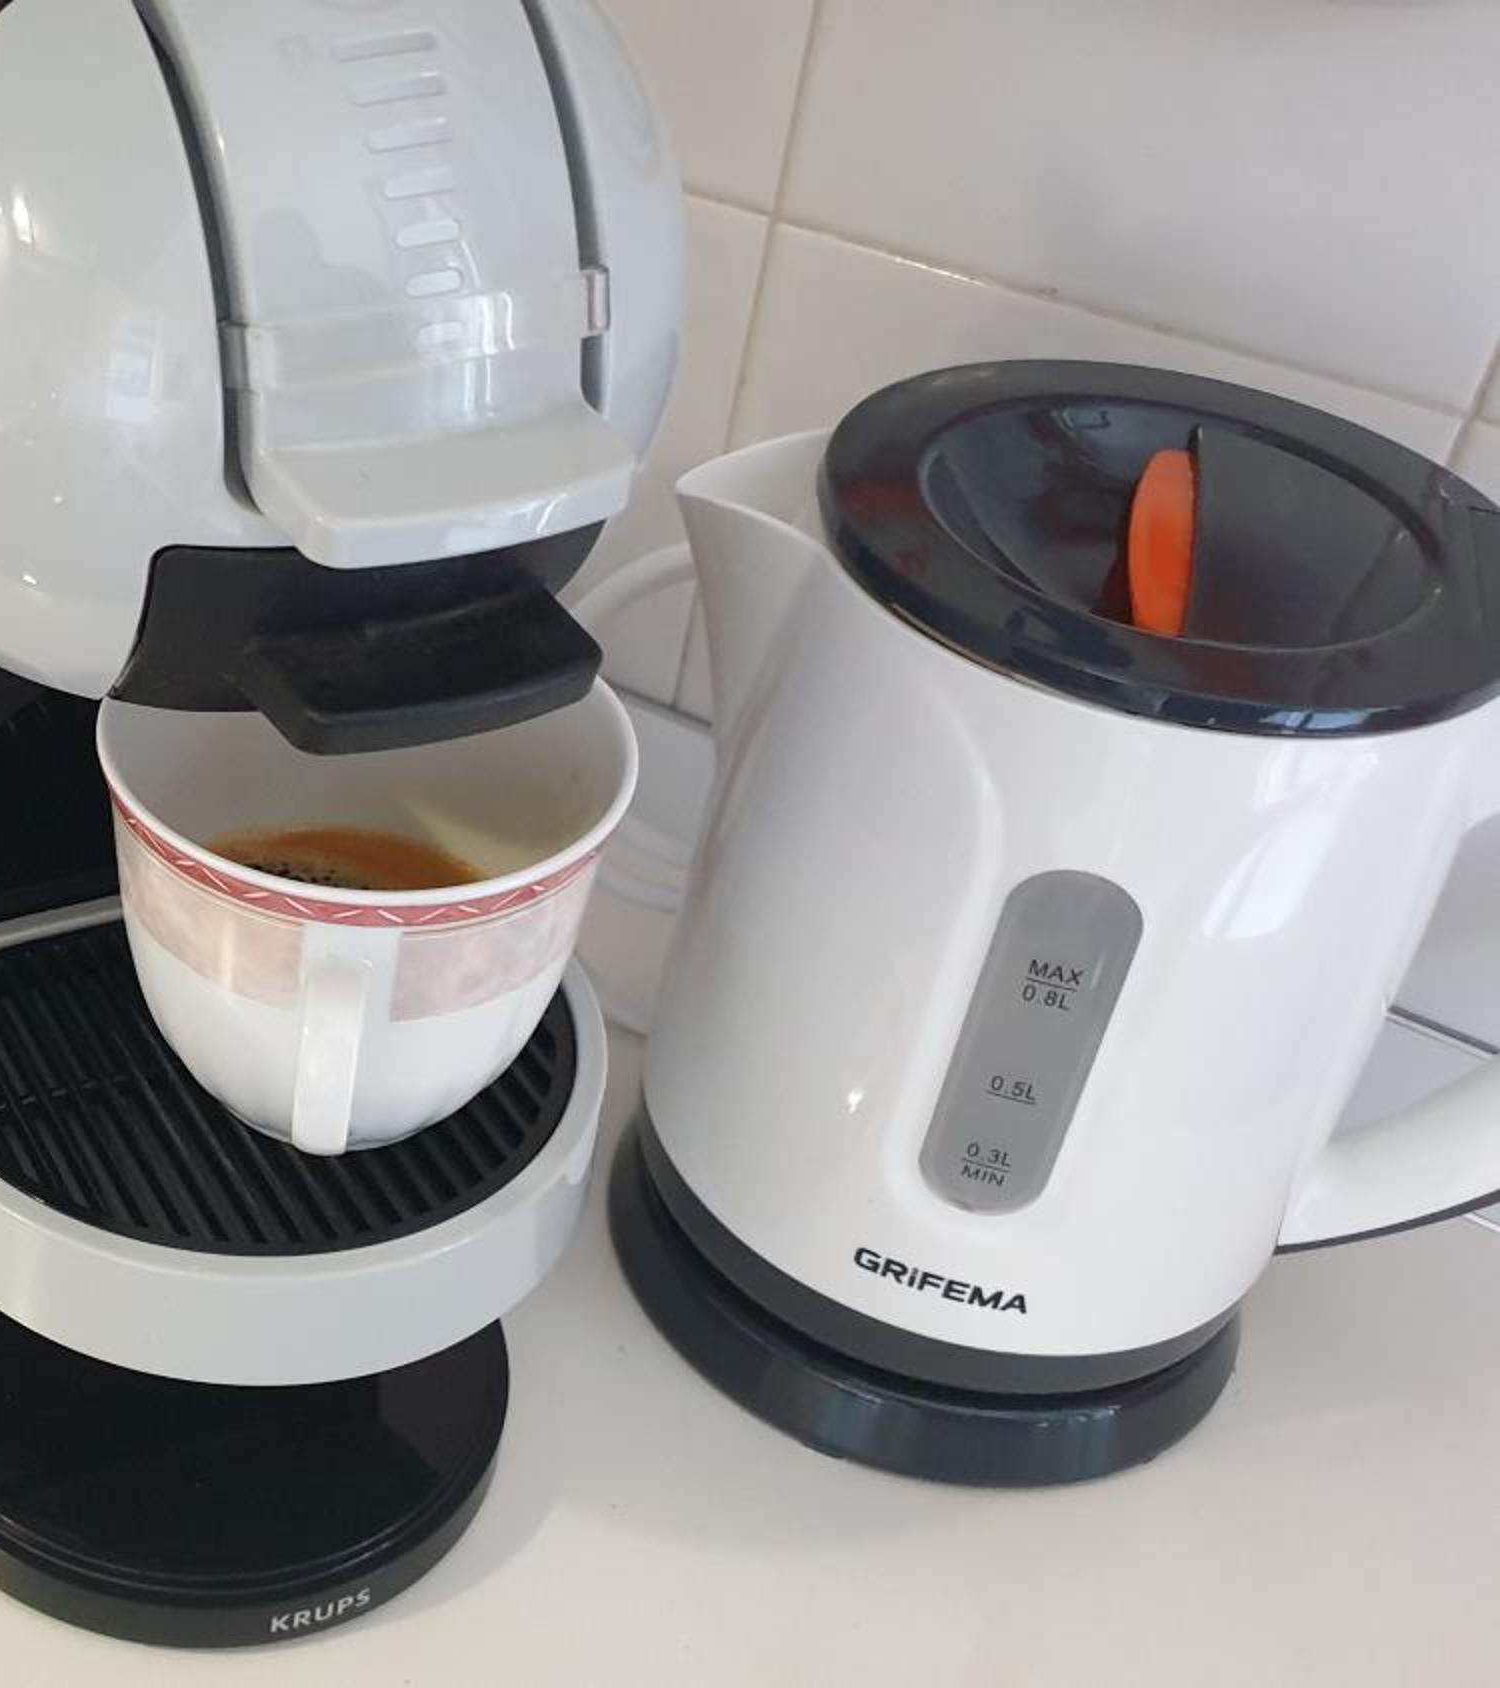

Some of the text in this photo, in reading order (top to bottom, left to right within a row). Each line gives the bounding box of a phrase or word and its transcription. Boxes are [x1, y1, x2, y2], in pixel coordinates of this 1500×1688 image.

[1028, 959, 1085, 985] MAX
[961, 1163, 1006, 1187] MIN
[270, 1587, 372, 1633] KRUPS
